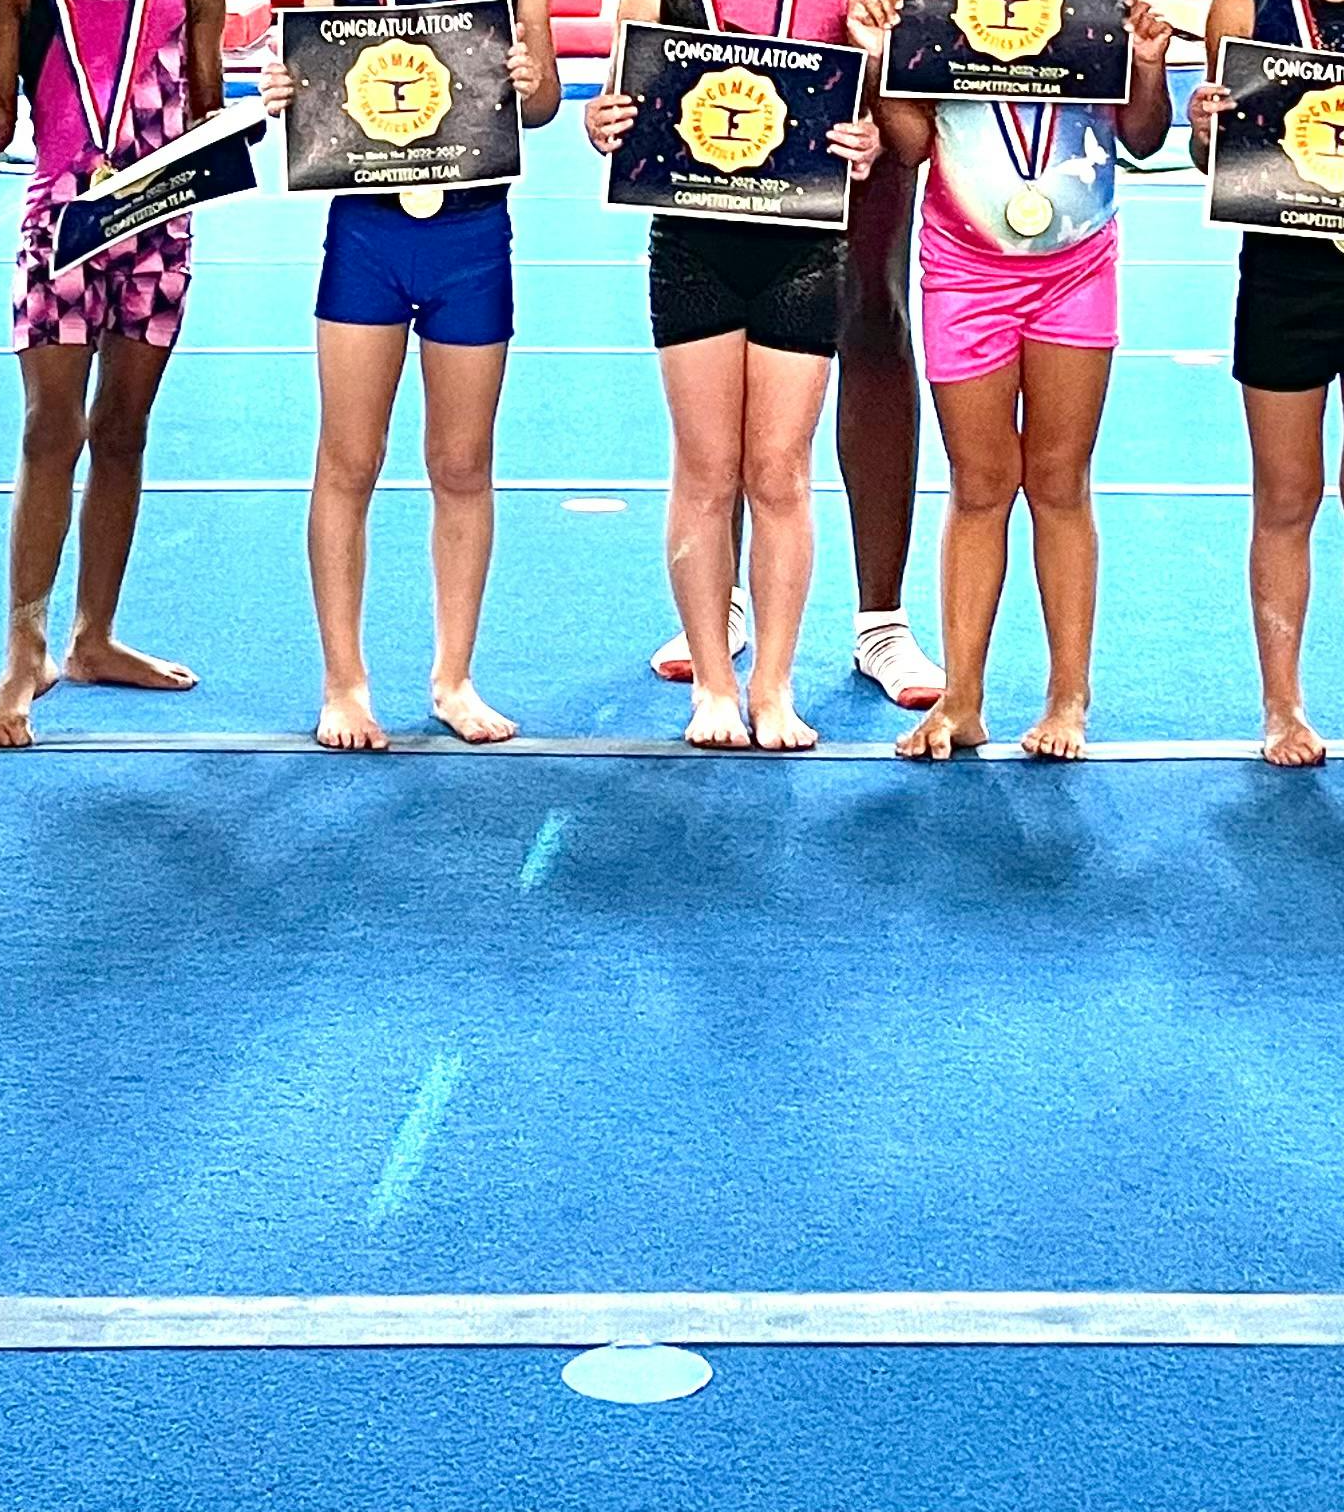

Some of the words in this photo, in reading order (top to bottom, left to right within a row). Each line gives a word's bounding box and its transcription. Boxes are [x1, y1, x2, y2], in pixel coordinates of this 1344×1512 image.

[320, 13, 473, 42] CONGRATULATIONS
[664, 39, 822, 70] CONGRATULATIONS
[953, 79, 1030, 93] COMPETITION
[1030, 81, 1061, 95] TEAM
[354, 168, 430, 183] COMPETITION
[431, 165, 461, 179] TEAM
[674, 191, 752, 210] COMPETITION
[752, 196, 782, 213] TEAM
